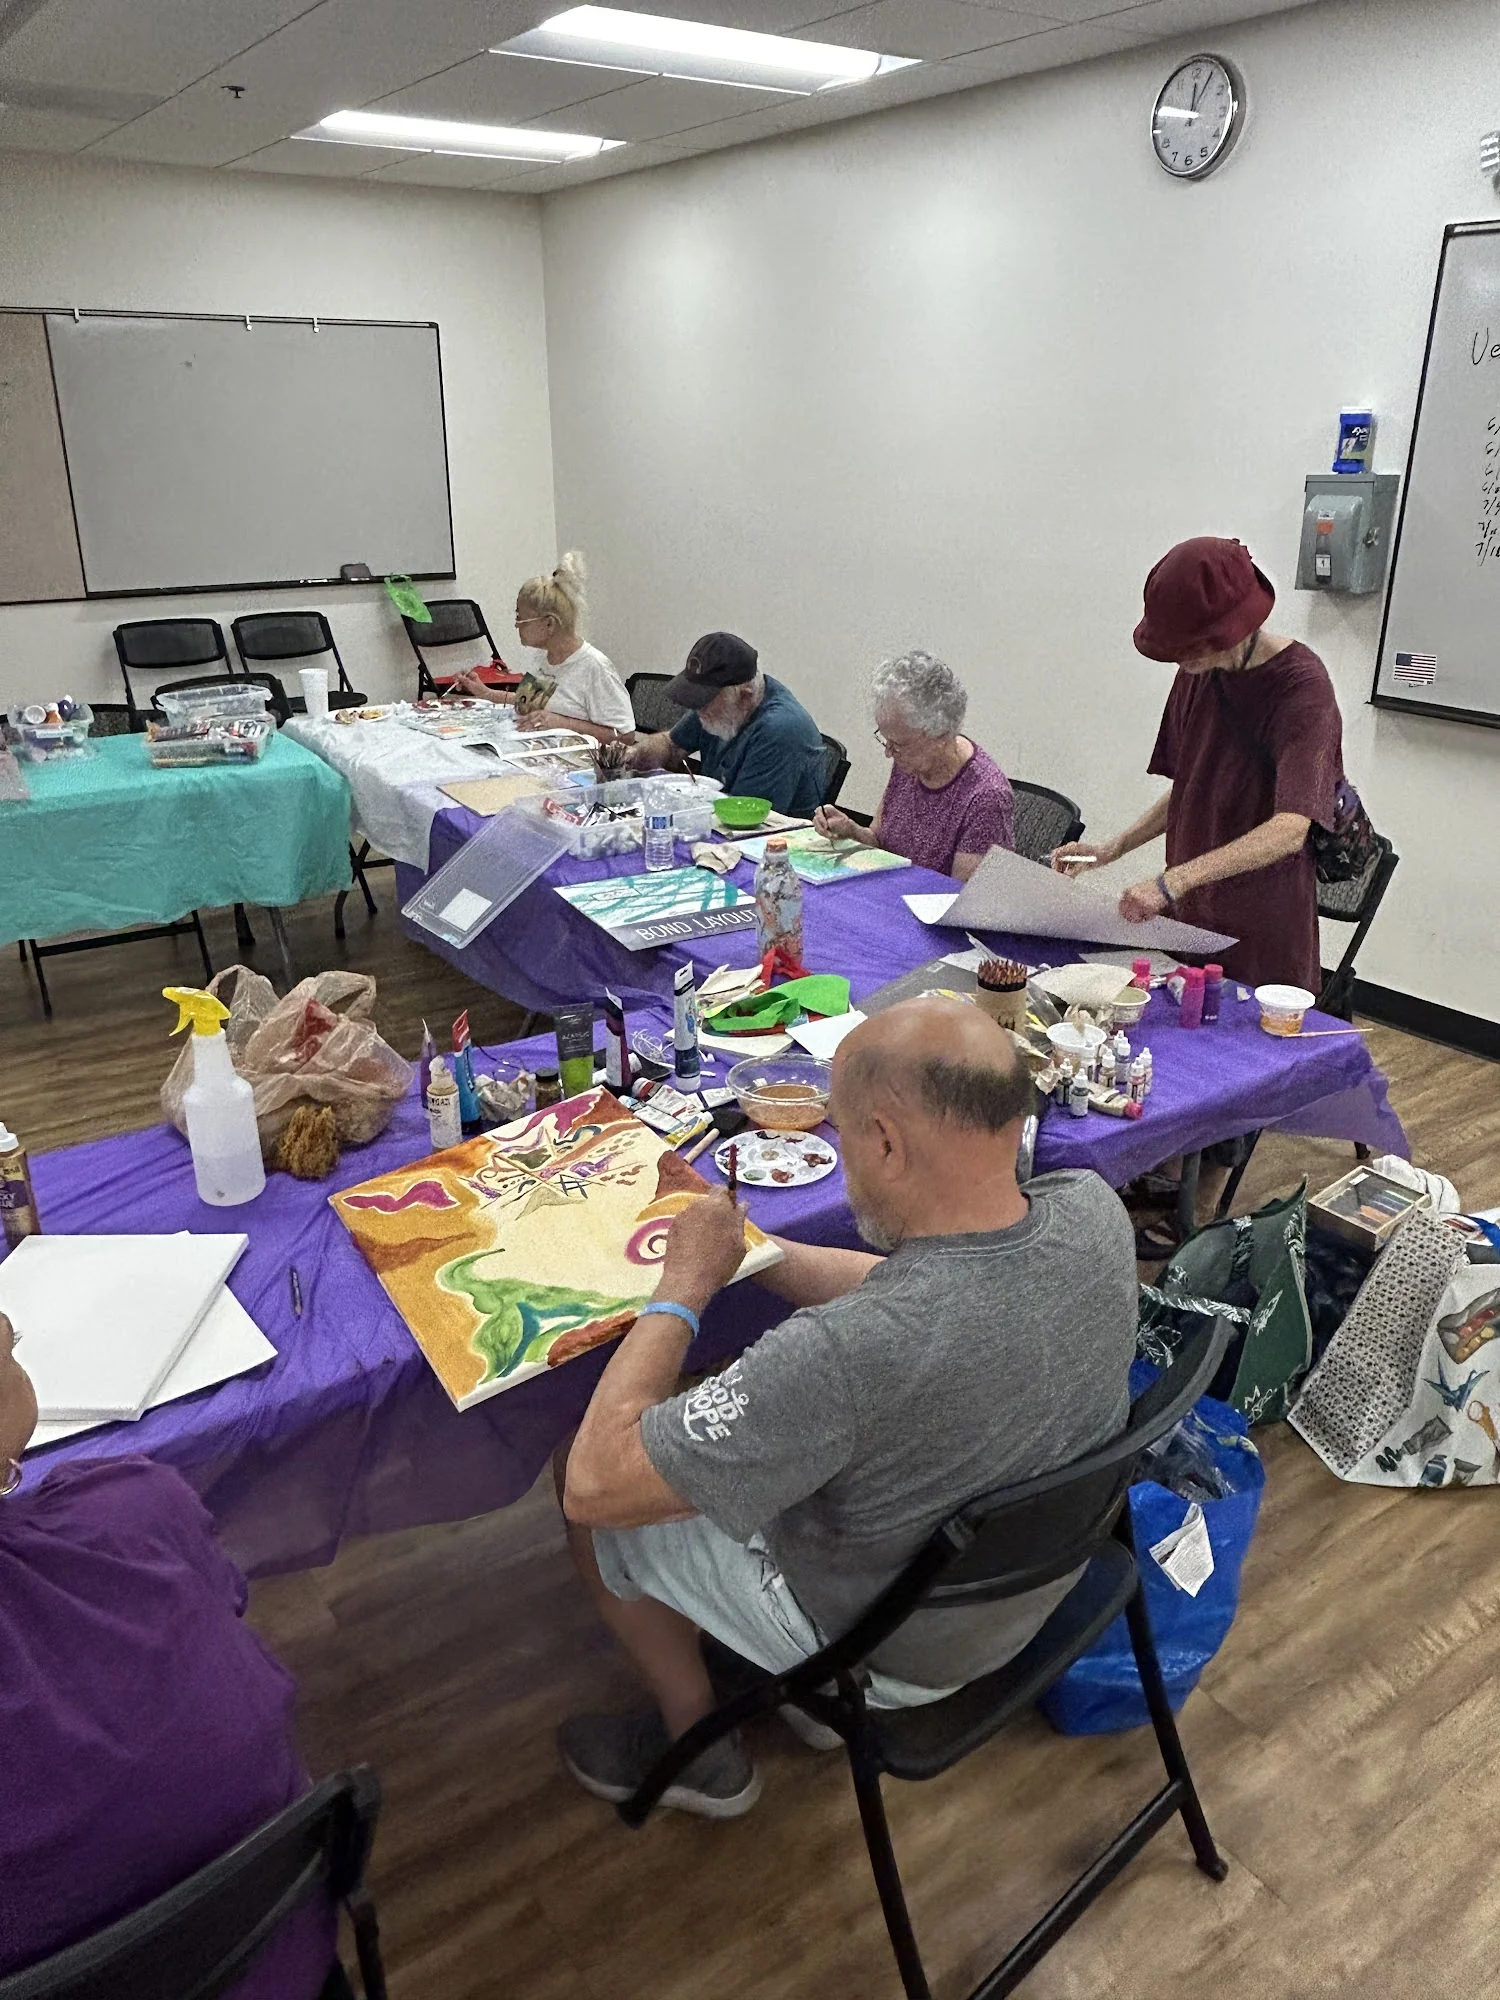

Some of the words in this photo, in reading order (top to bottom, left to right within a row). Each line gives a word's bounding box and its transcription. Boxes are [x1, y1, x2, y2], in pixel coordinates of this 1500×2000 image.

[1216, 84, 1224, 95] 2
[1212, 127, 1219, 138] 4
[1171, 151, 1179, 162] 7
[1200, 146, 1208, 158] 5
[1184, 155, 1192, 165] 6
[635, 921, 693, 941] BOND
[692, 909, 757, 930] LAYOUT
